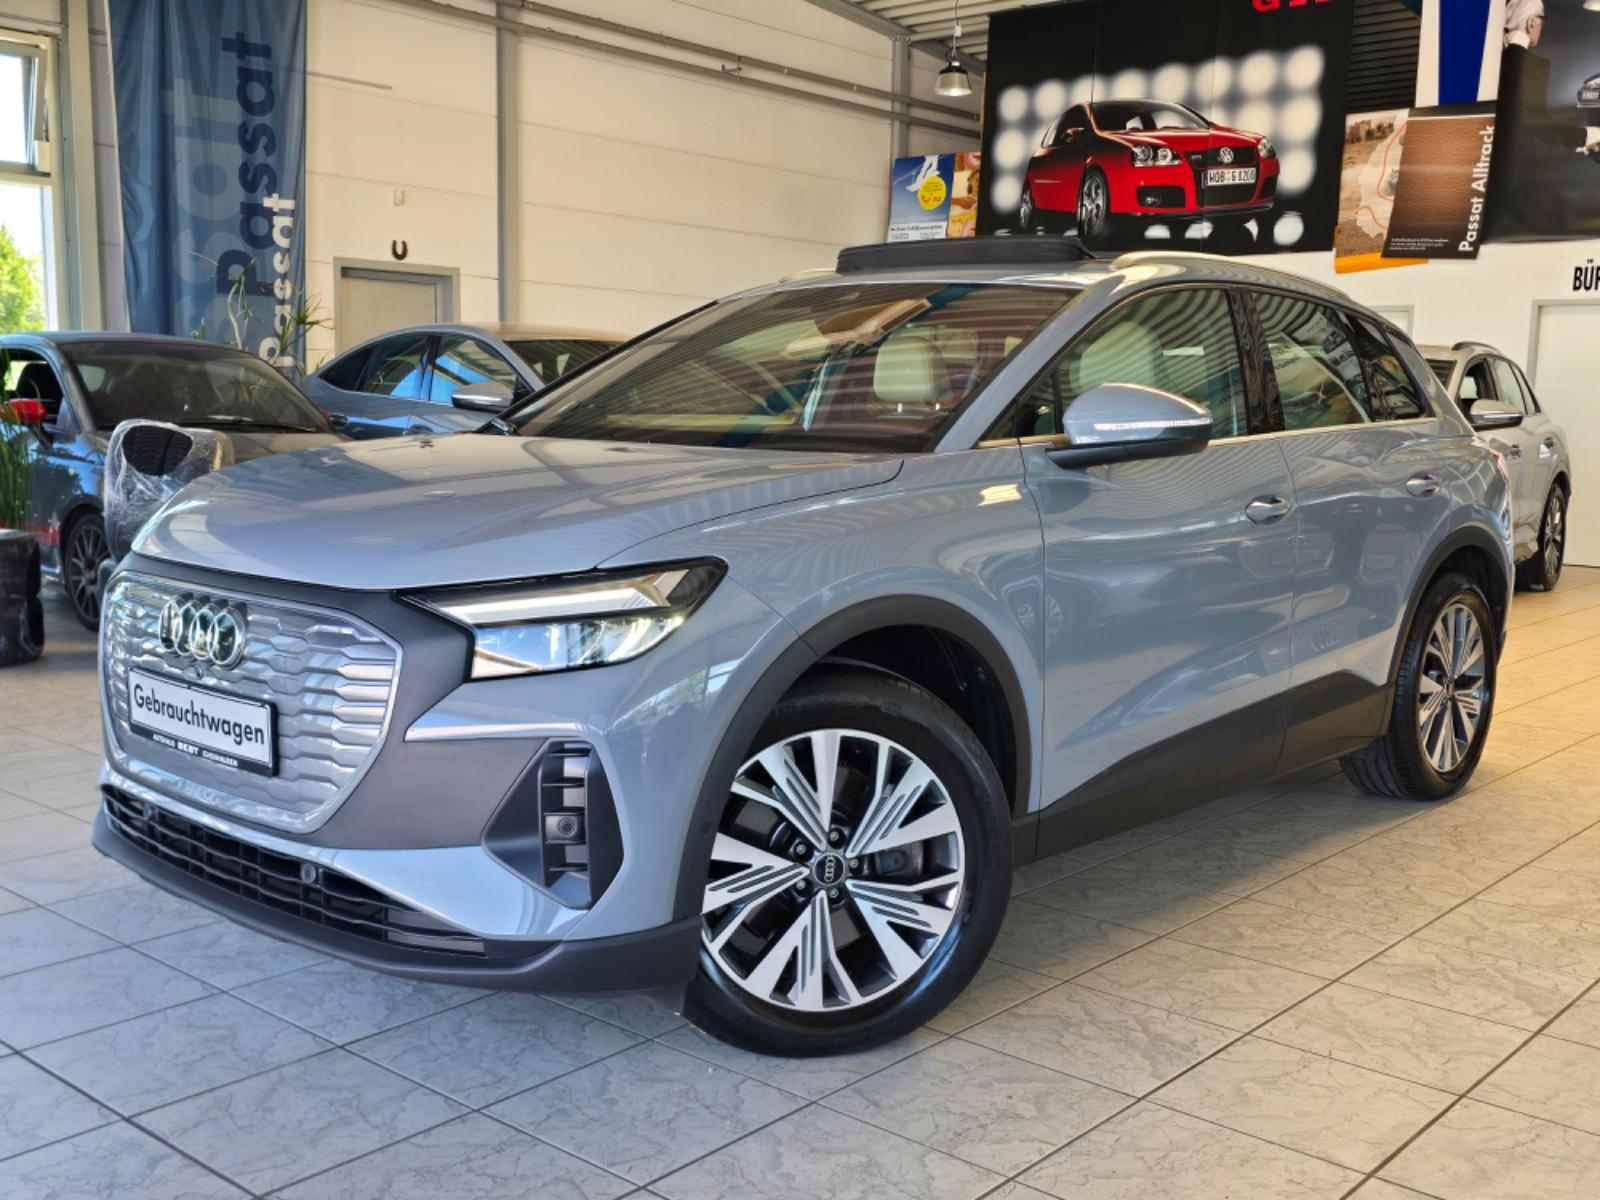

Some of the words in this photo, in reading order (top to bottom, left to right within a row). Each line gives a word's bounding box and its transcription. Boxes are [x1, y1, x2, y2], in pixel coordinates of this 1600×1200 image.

[216, 31, 278, 296] Passat
[1458, 196, 1484, 251] Passat
[1471, 125, 1495, 192] Alltrack
[258, 193, 296, 367] Passat
[133, 683, 265, 745] Gebrauchtwagen
